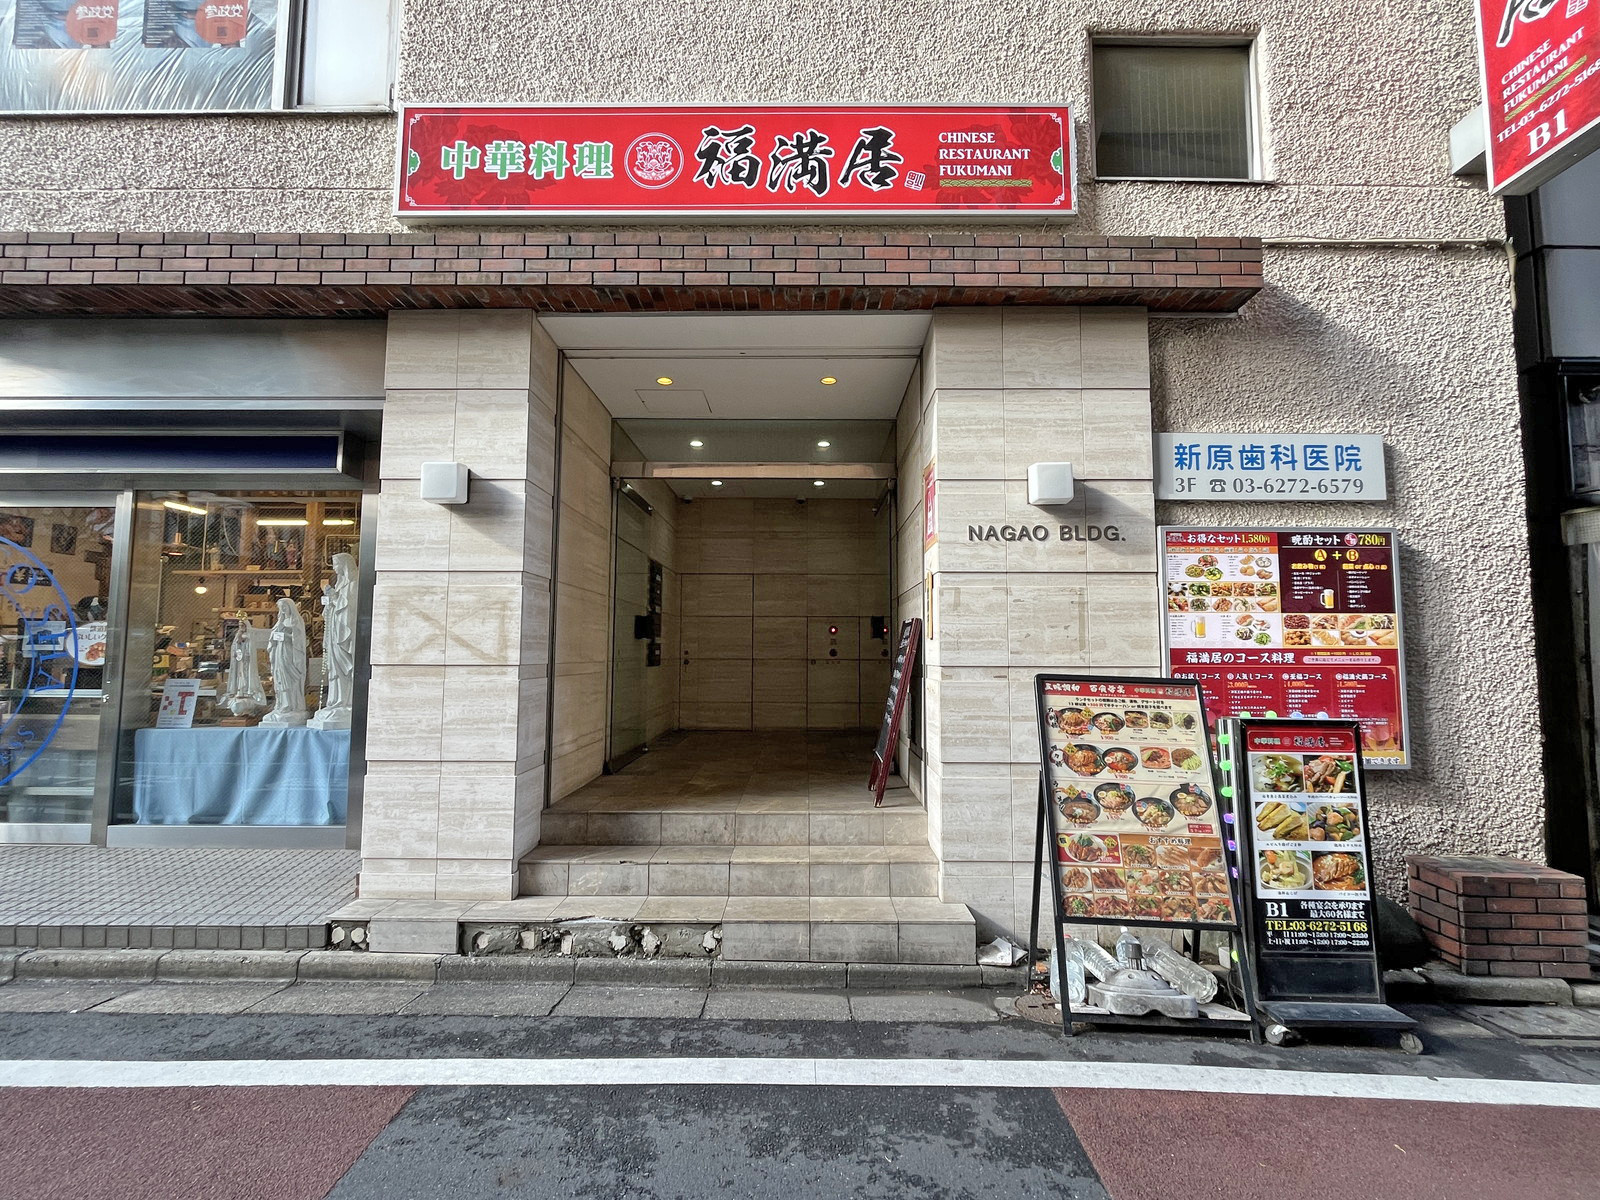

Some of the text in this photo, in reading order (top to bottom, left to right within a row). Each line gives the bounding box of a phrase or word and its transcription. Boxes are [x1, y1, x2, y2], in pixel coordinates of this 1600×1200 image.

[1501, 39, 1551, 85] CHINESE
[1503, 27, 1585, 99] RESTAURANT
[1504, 56, 1568, 114] FUKUMANI
[938, 132, 996, 145] CHINESE
[1527, 109, 1568, 156] B1
[439, 125, 906, 196] 中華料理 福満居
[938, 148, 1031, 161] RESTAURANT
[938, 164, 1013, 178] FUKUMANI
[1174, 443, 1363, 472] 新原歯科医院
[1175, 477, 1365, 494] 3F 03-6272-6579
[968, 525, 1127, 541] NAGAO BLDG.
[1291, 534, 1341, 546] 晩酌セット
[1358, 534, 1386, 546] 780円
[1186, 652, 1296, 664] 福満居のコース料理
[1149, 836, 1192, 846] おすすめ料理
[1265, 902, 1289, 917] B1
[1300, 901, 1365, 911] 各種宴会を承ります
[1309, 910, 1365, 919] 最大60名様まで
[1265, 920, 1368, 932] TEL:03-6272-5168
